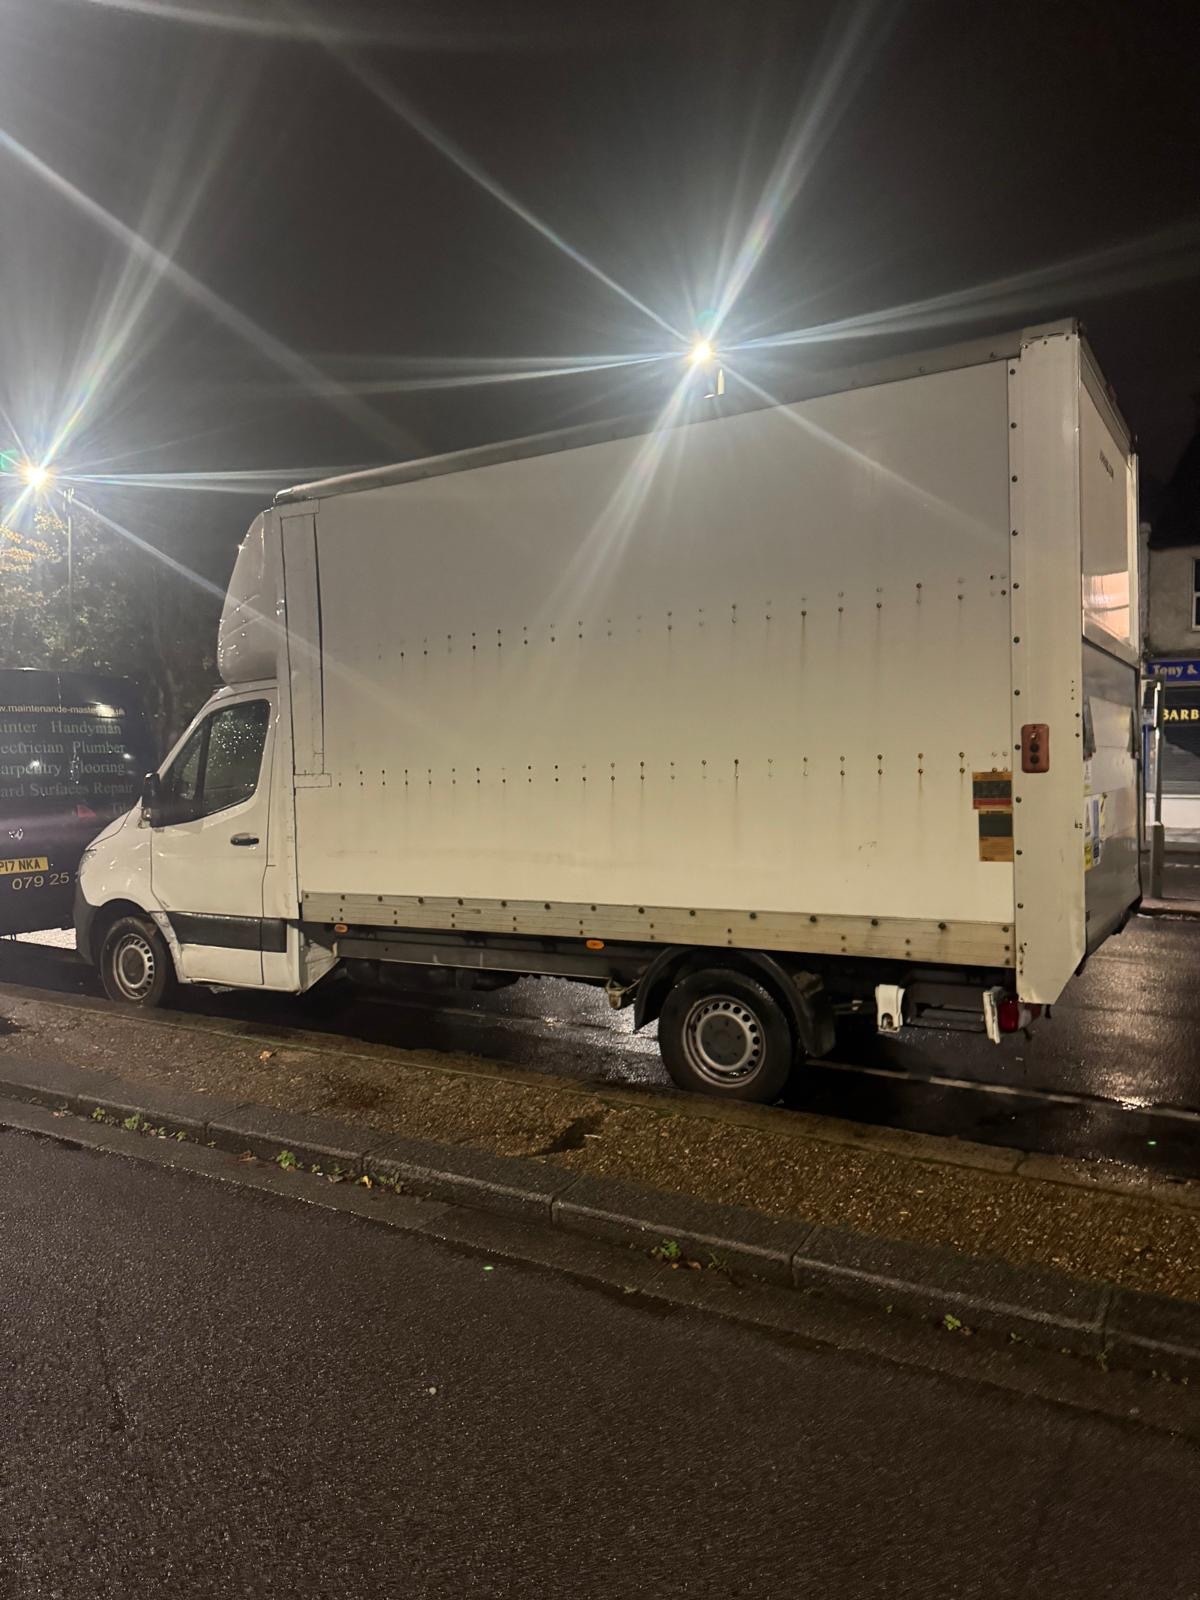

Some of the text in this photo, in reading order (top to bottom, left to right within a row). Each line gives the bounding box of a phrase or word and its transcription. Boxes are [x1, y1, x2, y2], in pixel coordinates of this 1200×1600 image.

[51, 720, 122, 736] Handyman
[73, 740, 126, 754] Plumber
[93, 782, 134, 797] Repair
[19, 858, 41, 871] NKA
[12, 875, 44, 890] 079
[49, 871, 70, 886] 25
